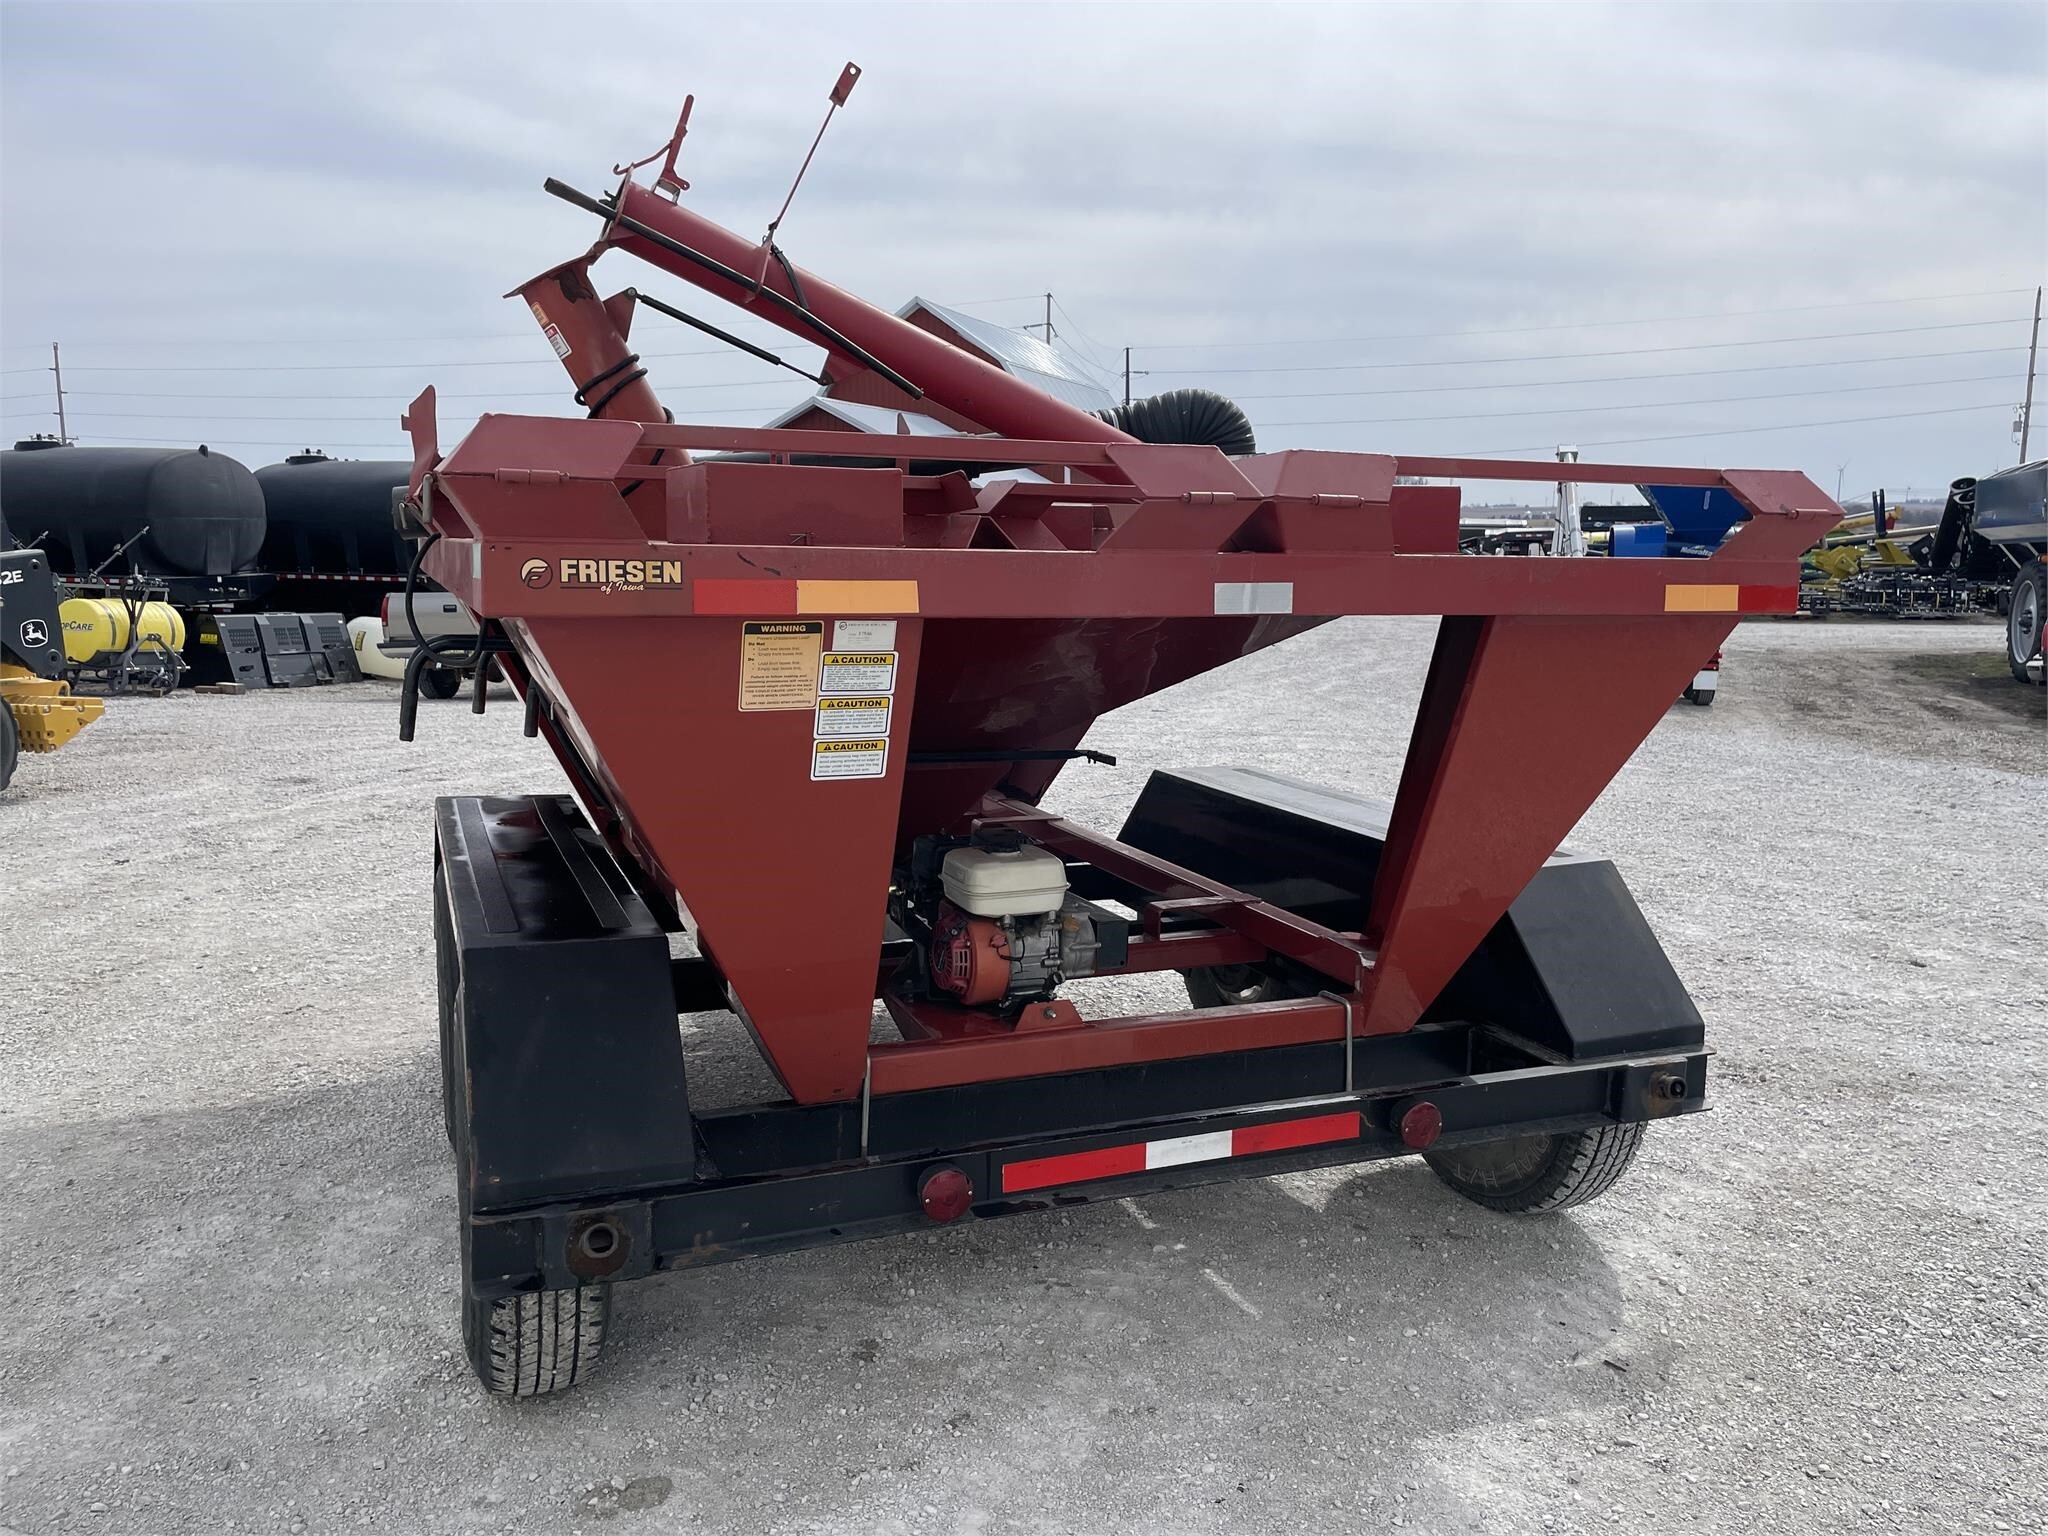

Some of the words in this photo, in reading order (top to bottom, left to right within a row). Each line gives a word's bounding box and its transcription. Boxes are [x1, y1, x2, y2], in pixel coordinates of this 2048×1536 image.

[560, 558, 682, 583] FRIESEN
[0, 569, 24, 585] 2E
[600, 580, 613, 594] of
[615, 580, 646, 592] Iowa
[61, 620, 94, 631] OPCARE
[841, 656, 887, 664] CAUTION
[836, 700, 882, 708] CAUTION
[833, 742, 878, 751] CAUTION
